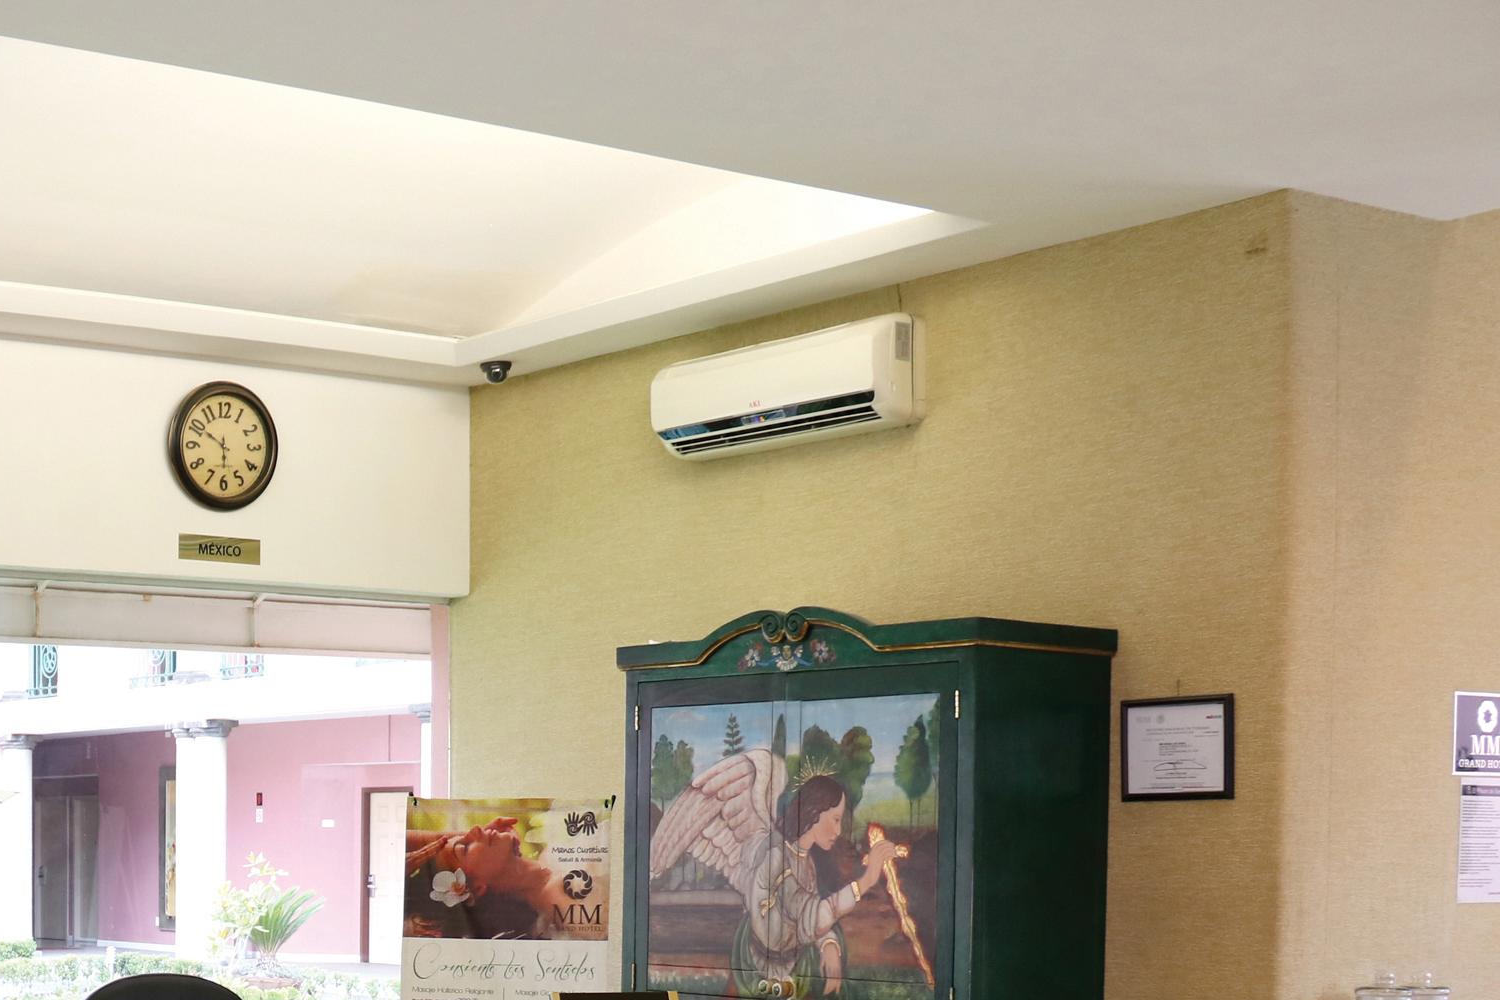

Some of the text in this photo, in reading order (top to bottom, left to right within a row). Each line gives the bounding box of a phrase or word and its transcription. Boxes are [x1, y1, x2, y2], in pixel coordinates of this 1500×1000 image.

[201, 405, 215, 424] 11
[217, 402, 232, 419] 12
[233, 408, 245, 424] 1
[188, 419, 206, 438] 10
[242, 423, 258, 437] 2
[185, 440, 201, 450] 9
[246, 443, 262, 452] 3
[189, 457, 205, 471] 8
[243, 458, 258, 473] 4
[204, 468, 215, 486] 7
[219, 474, 228, 492] 6
[233, 470, 245, 487] 5
[198, 543, 242, 558] MÉXICO
[1469, 734, 1500, 756] MM
[1458, 758, 1487, 769] GRAND
[551, 846, 575, 855] Manos
[551, 903, 603, 925] MM
